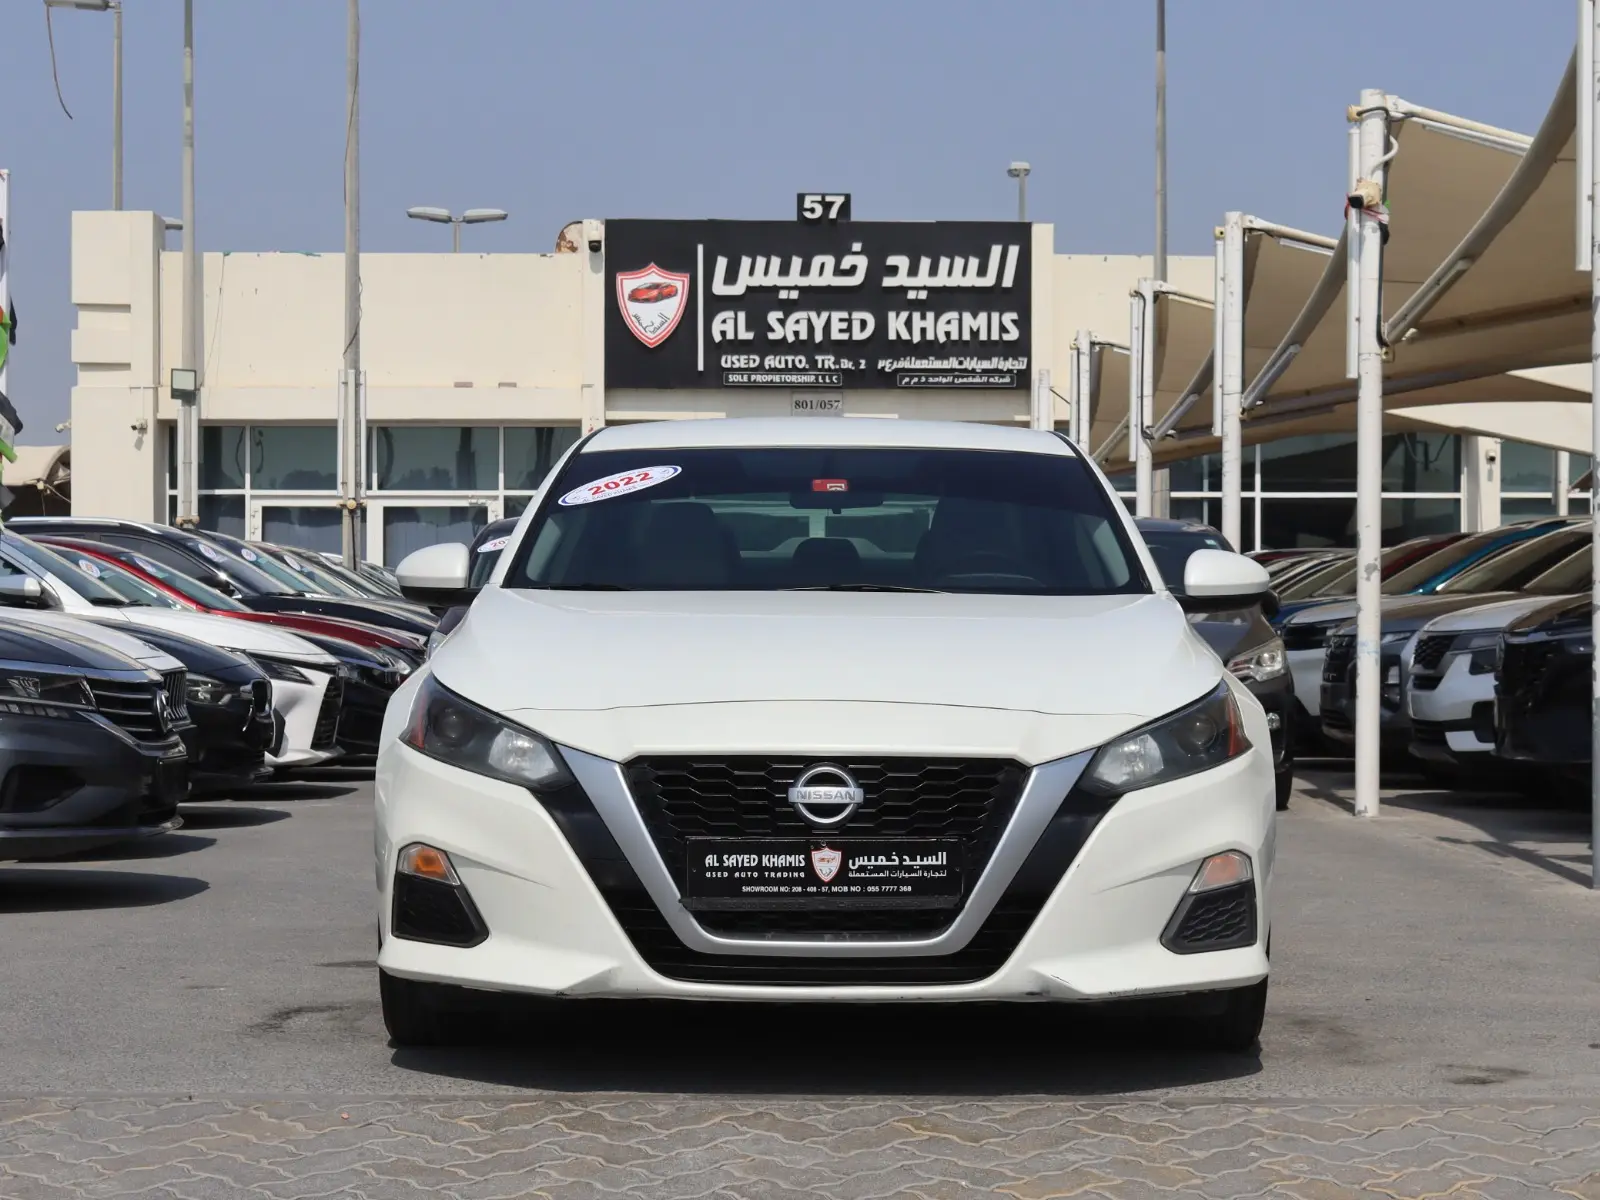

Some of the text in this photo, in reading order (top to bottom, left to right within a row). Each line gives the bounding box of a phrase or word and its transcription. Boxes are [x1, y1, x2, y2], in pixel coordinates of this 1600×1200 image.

[802, 195, 845, 219] 57
[712, 242, 1020, 300] السيد خميس
[712, 310, 1020, 344] AL SAYED KHAMIS
[720, 355, 761, 369] USED
[764, 355, 809, 370] AUTO.
[859, 359, 866, 369] 2
[998, 357, 1028, 373] لتجارة
[728, 374, 749, 382] SOLE
[819, 375, 823, 383] L
[825, 375, 830, 383] L
[832, 375, 838, 383] C
[794, 399, 841, 410] 801/057
[588, 472, 654, 496] 2022
[796, 790, 856, 801] NISSAN
[705, 854, 806, 868] AL SAYED KHAMIS
[848, 851, 947, 870] السيد خميس
[848, 869, 947, 878] لتجارة السيارات المستعملة
[742, 885, 778, 893] SHOWROOM
[780, 885, 790, 893] NO:
